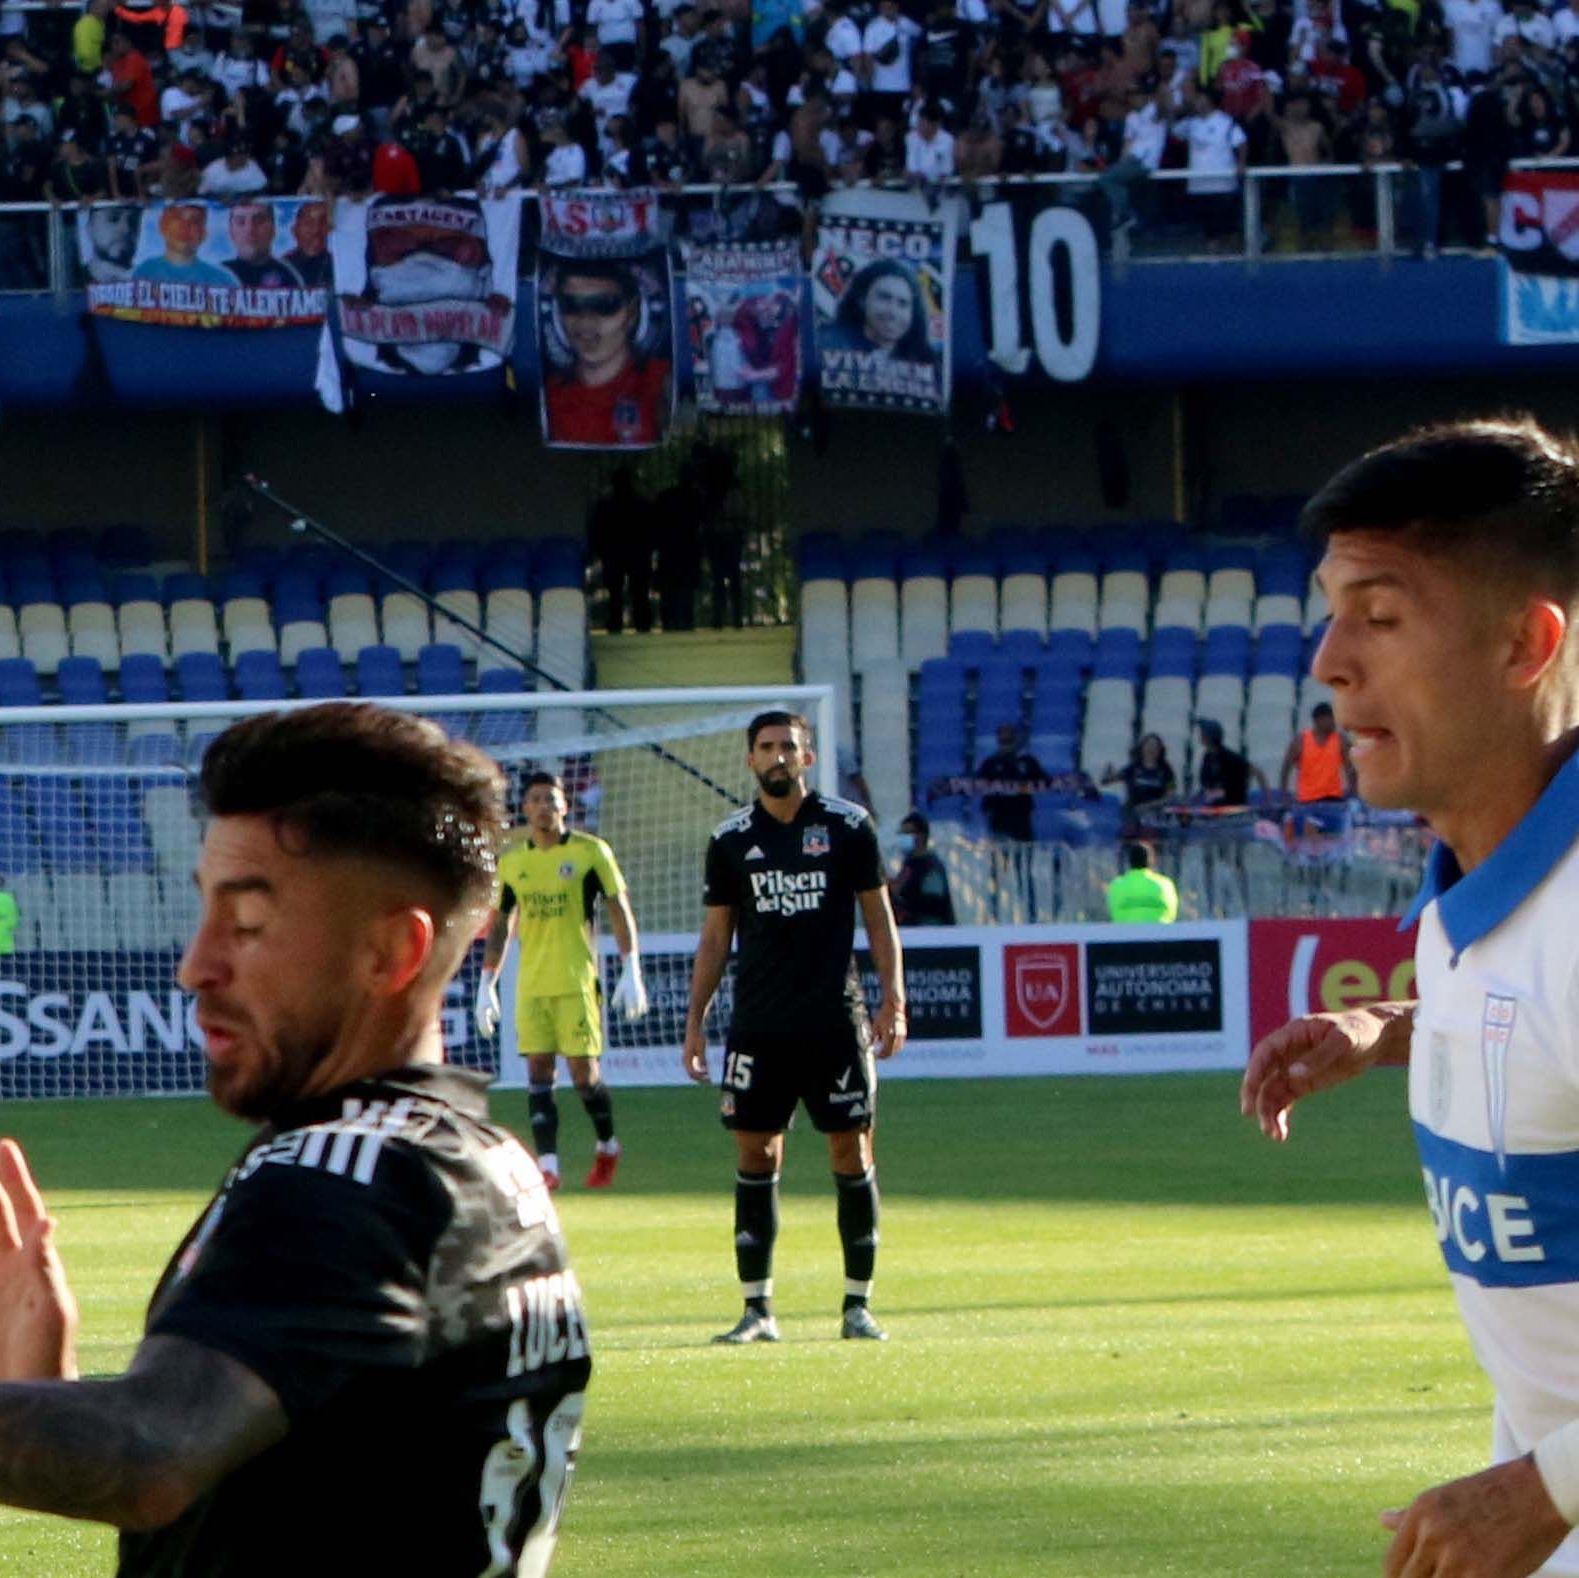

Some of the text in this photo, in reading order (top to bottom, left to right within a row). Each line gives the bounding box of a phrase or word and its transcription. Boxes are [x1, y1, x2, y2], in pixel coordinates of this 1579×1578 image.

[970, 202, 1100, 382] 10
[750, 869, 827, 897] Pilsen
[756, 891, 826, 918] del Sur
[1094, 962, 1213, 981] UNIVERSIDAD
[724, 1051, 755, 1091] 15
